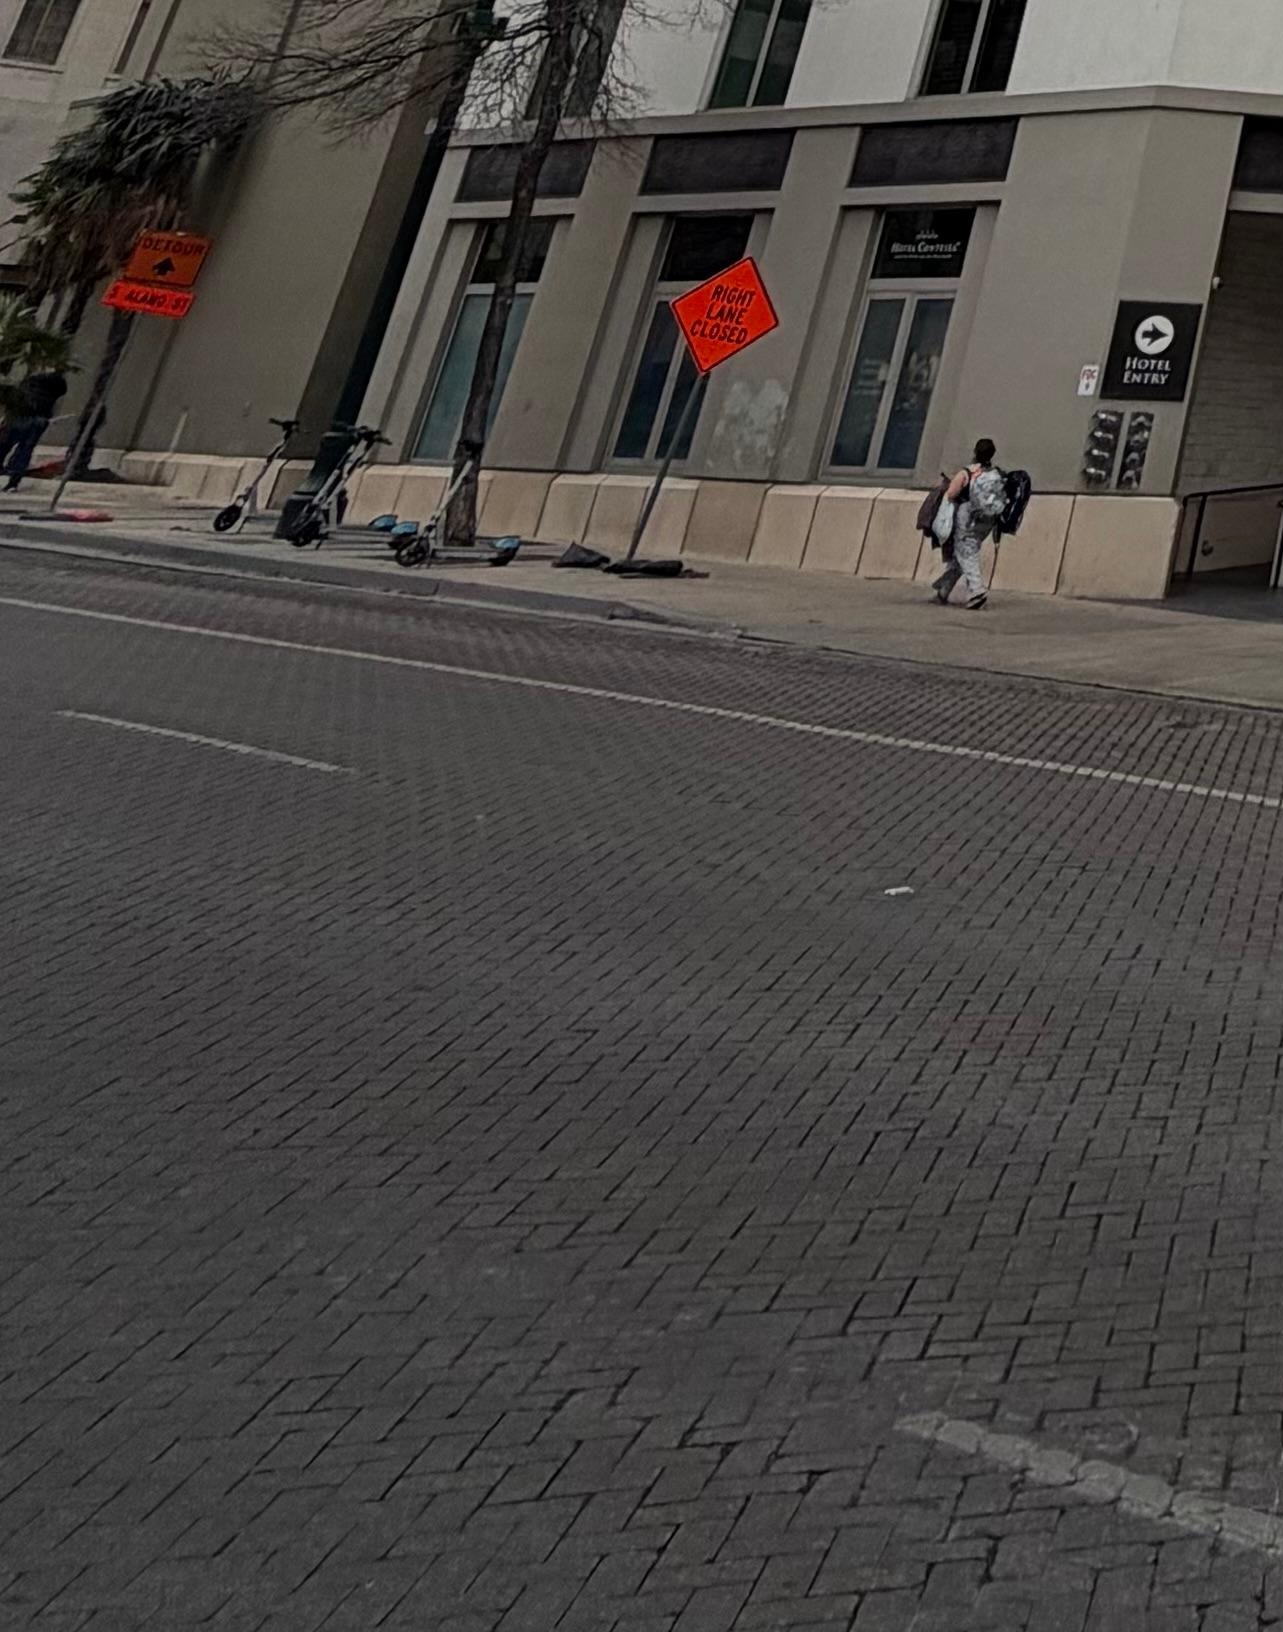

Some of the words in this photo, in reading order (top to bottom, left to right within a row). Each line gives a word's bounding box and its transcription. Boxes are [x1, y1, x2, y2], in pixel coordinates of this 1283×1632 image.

[142, 237, 206, 255] DETOUR
[710, 284, 756, 308] RIGHT
[706, 301, 748, 326] LANE
[690, 319, 748, 344] CLOSED
[1125, 356, 1172, 371] HOTEL
[1123, 370, 1169, 385] ENTRY
